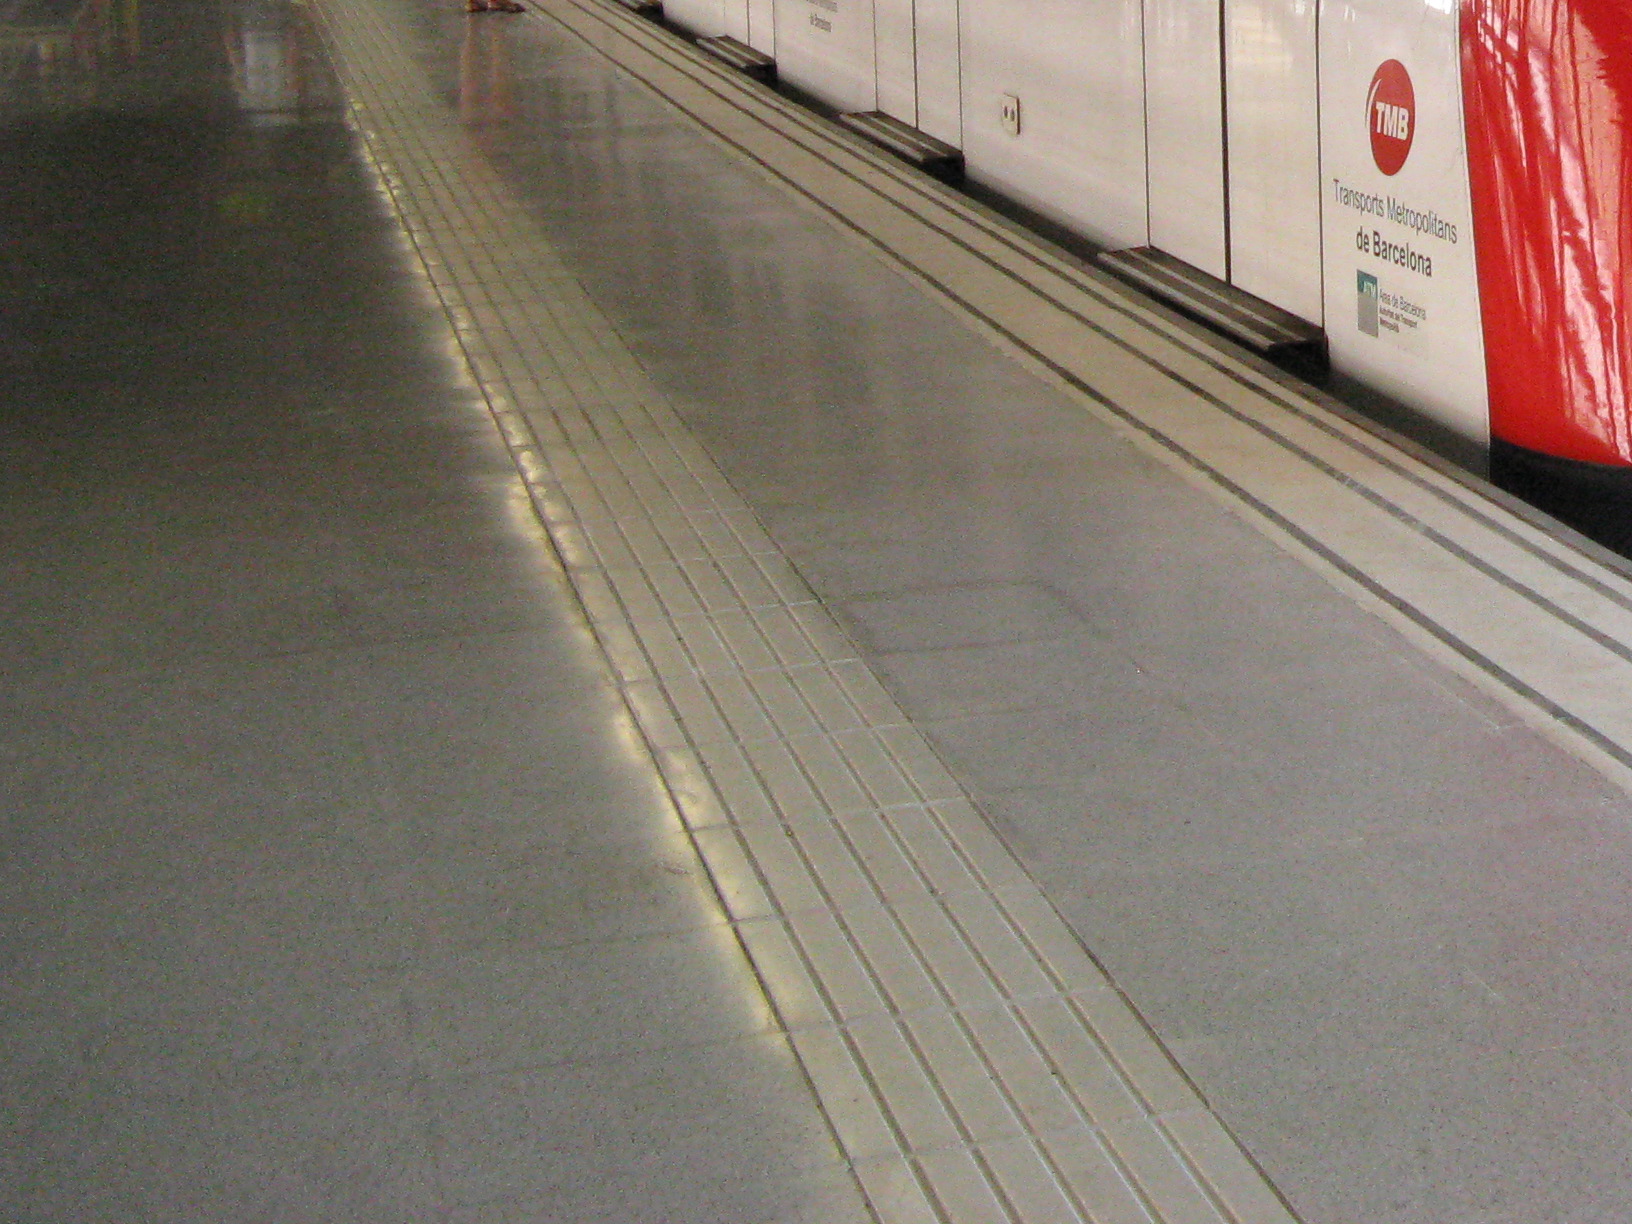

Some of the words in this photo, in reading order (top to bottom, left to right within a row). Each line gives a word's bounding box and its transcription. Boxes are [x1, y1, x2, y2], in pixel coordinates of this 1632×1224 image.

[1375, 101, 1410, 141] TMB
[1333, 178, 1385, 218] Transports
[1387, 195, 1458, 245] Metropolitans
[1356, 225, 1370, 253] de
[1373, 230, 1433, 278] Barcelona
